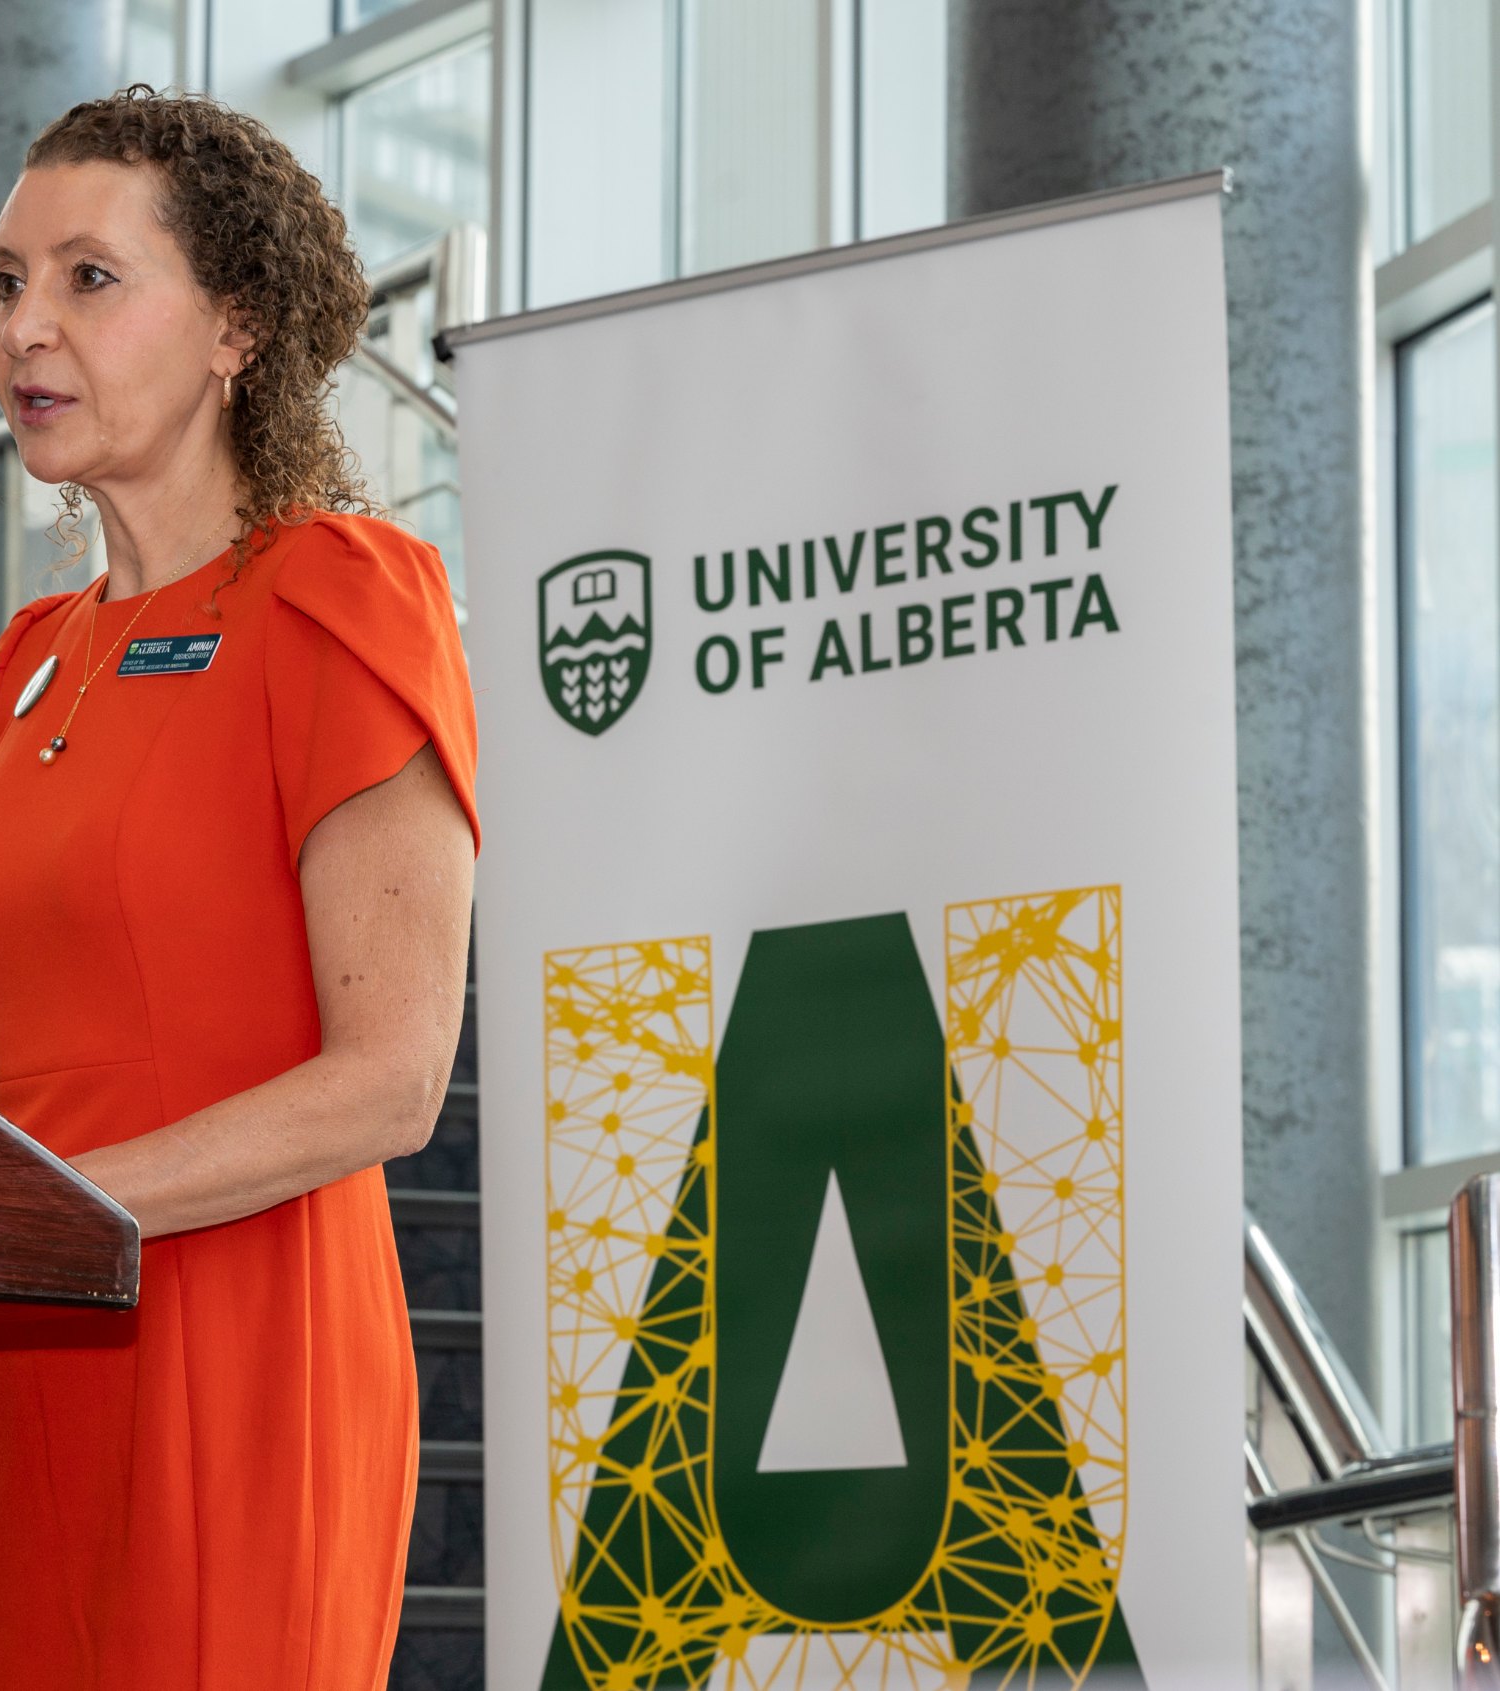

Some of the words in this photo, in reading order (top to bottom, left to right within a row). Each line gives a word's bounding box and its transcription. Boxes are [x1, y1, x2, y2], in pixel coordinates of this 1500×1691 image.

[693, 484, 1119, 613] UNIVERSITY
[136, 645, 170, 655] ALBERTA
[186, 641, 216, 652] AMINAH
[694, 625, 786, 695] OF
[808, 572, 1121, 682] ALBERTA
